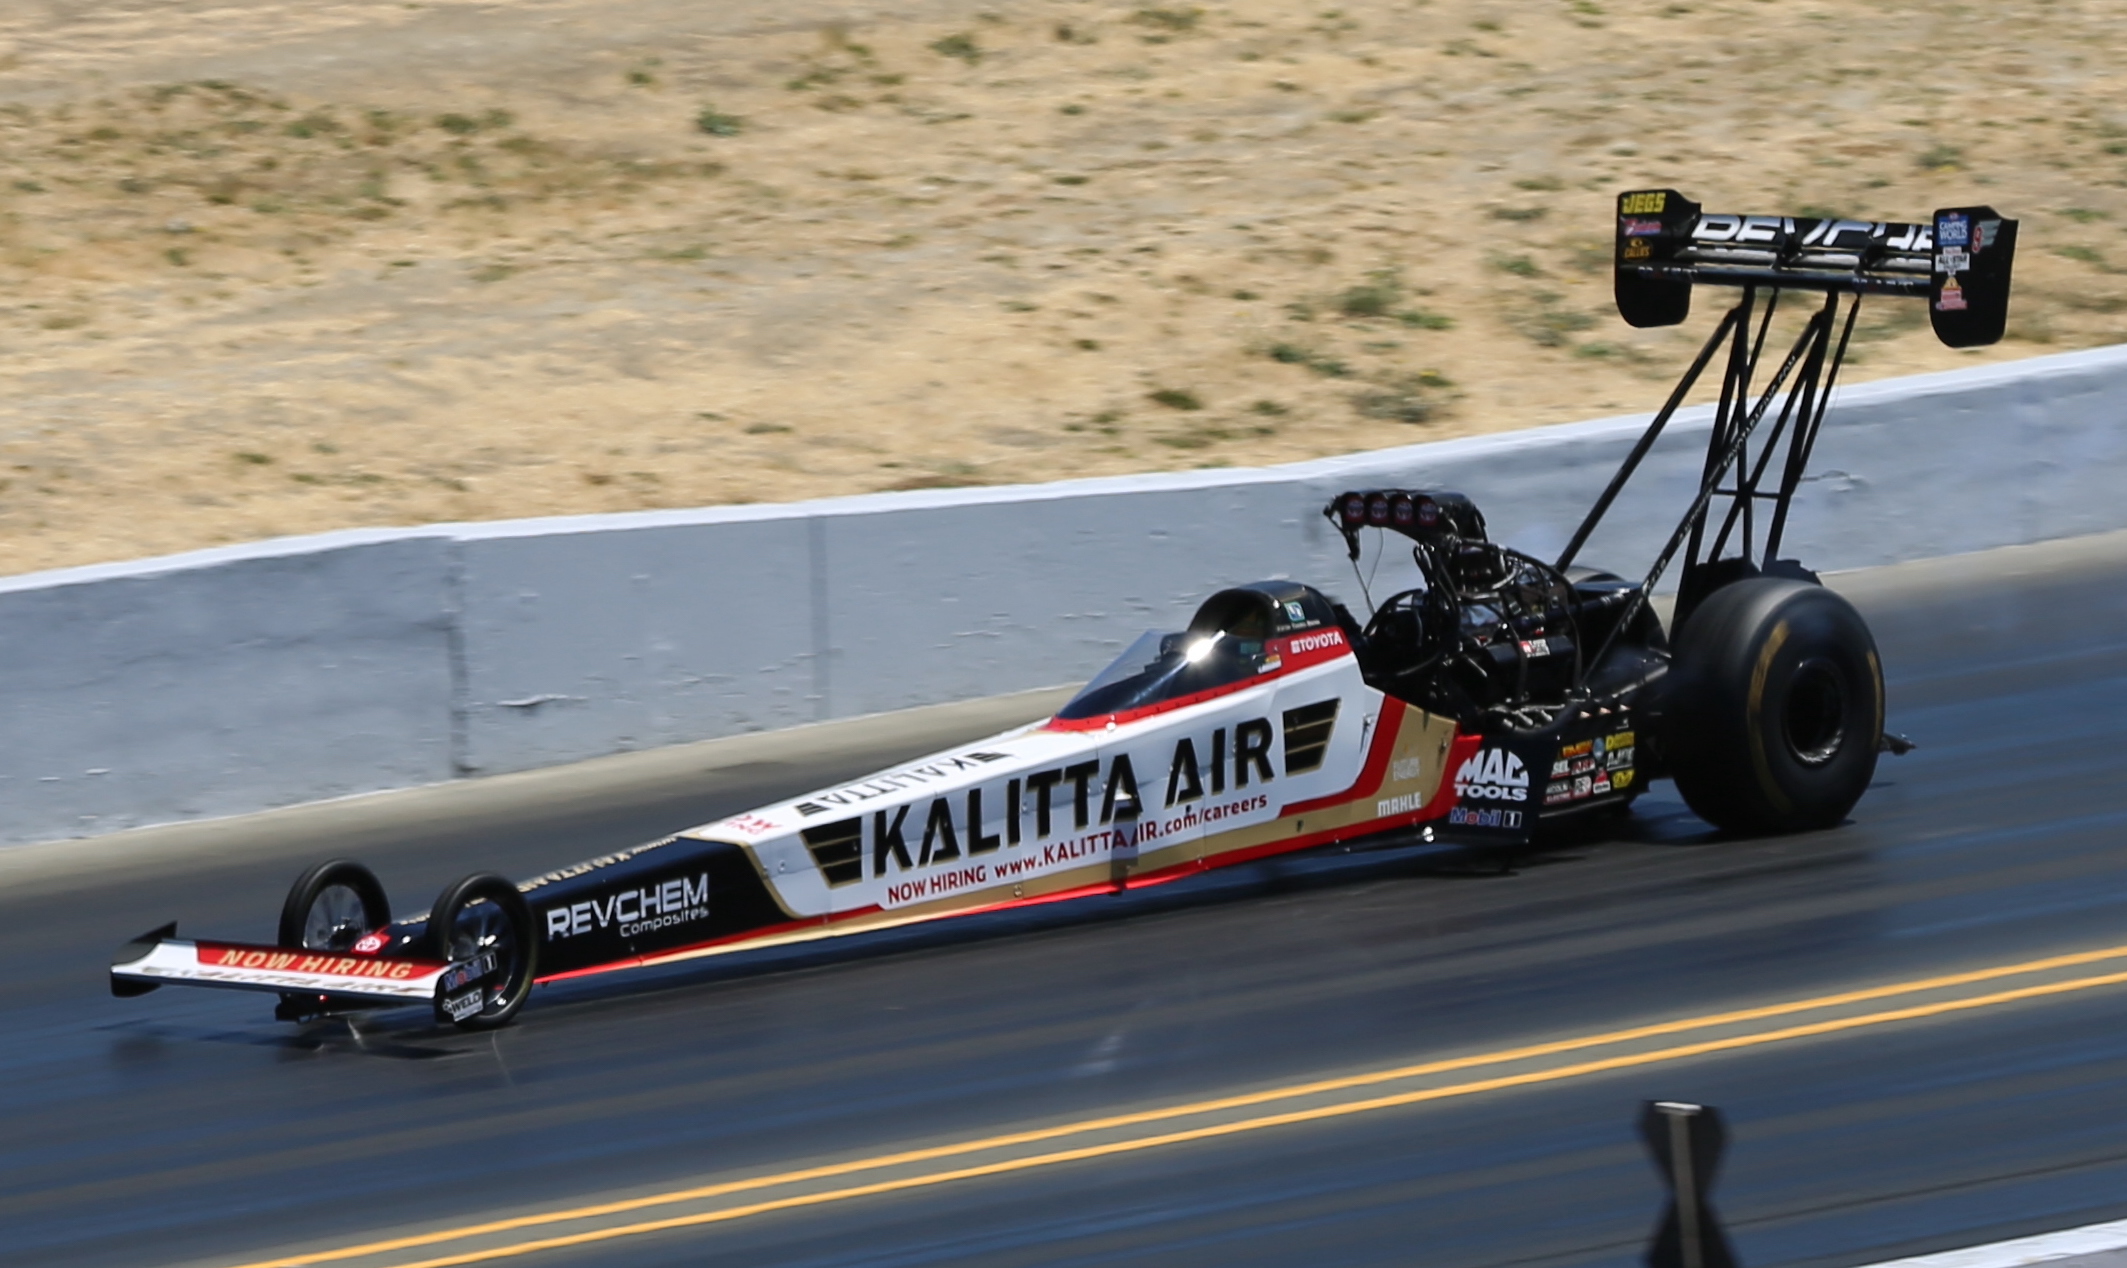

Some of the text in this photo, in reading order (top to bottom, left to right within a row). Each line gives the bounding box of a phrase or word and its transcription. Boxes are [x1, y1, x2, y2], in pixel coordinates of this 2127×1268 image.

[1622, 192, 1666, 214] JEGS
[1300, 631, 1344, 652] TOYOTA
[1454, 748, 1529, 788] MAC
[873, 717, 1275, 878] KALITTA AIR
[1377, 791, 1422, 818] MAHLE
[1454, 784, 1528, 802] TOOLS
[1450, 807, 1501, 827] Mobil
[887, 879, 927, 904] NOW
[931, 865, 987, 895] HIRING
[546, 872, 709, 942] REVCHEM
[619, 905, 710, 938] Composites
[219, 949, 299, 970] NOW
[301, 954, 414, 980] HIRING
[451, 990, 481, 1017] WELD
